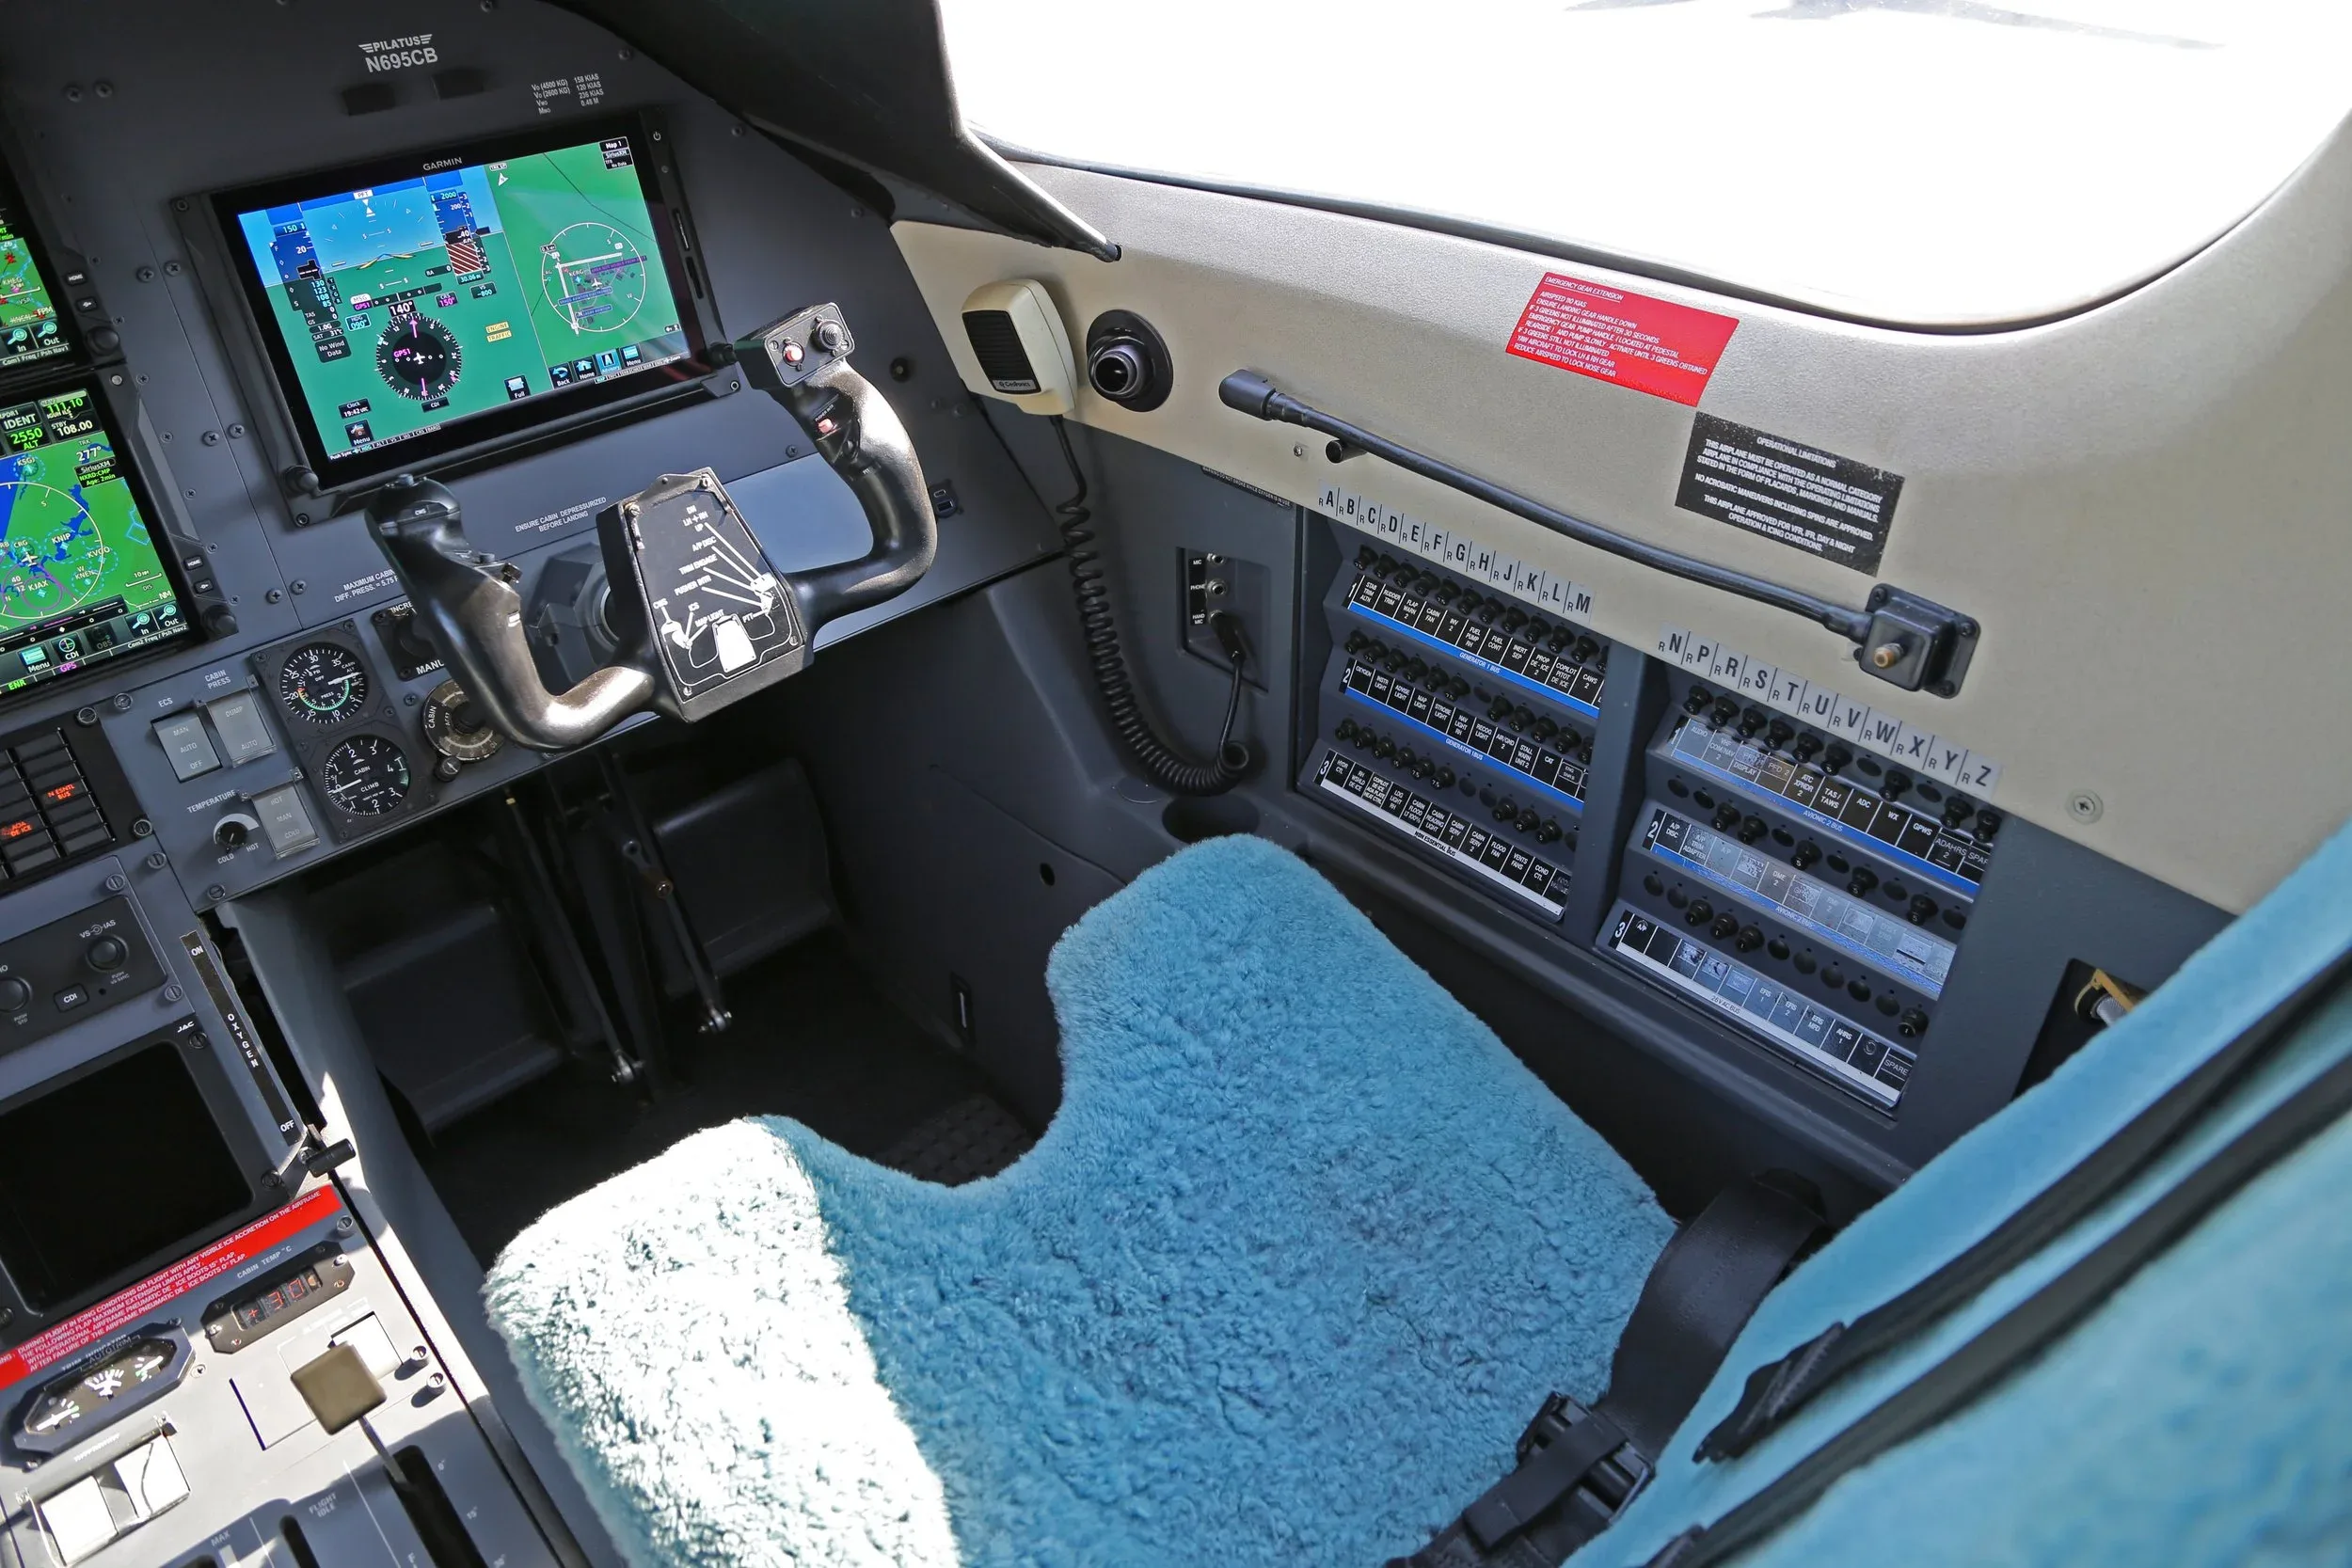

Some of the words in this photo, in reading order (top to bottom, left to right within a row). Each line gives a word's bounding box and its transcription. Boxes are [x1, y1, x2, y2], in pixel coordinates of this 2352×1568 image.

[373, 36, 421, 53] PILATUS
[365, 47, 438, 73] N695CB
[423, 157, 462, 171] GARMIN
[440, 190, 457, 199] 2000
[282, 224, 297, 234] 150
[296, 245, 307, 254] 20
[311, 279, 325, 288] 130
[1545, 276, 1578, 289] EMERGENCY
[1577, 284, 1593, 293] GEAR
[1591, 288, 1624, 300] EXTENSION
[355, 301, 371, 310] GPS1
[389, 301, 414, 314] 140°
[1535, 297, 1557, 309] ENSURE
[1556, 303, 1581, 314] LANDING
[1580, 309, 1597, 319] GEAR
[1596, 313, 1619, 325] HANDLE
[1618, 319, 1637, 329] DOWN
[350, 319, 367, 329] 090°
[486, 322, 508, 332] ENGINE
[44, 337, 60, 346] Out
[487, 331, 512, 341] TRAFFIC
[328, 340, 345, 350] Wind
[326, 348, 342, 357] Data
[557, 378, 570, 387] Back
[47, 398, 83, 414] 111.10
[6, 413, 36, 430] IDENT
[56, 420, 93, 436] 108.00
[10, 428, 43, 443] 2550
[353, 436, 371, 446] Menu
[23, 439, 39, 450] ALT
[76, 446, 102, 461] 277°
[1756, 436, 1799, 456] OPERATIONAL
[1798, 450, 1836, 468] LIMITATIONS
[1705, 438, 1719, 451] THIS
[1718, 443, 1748, 460] AIRPLANE
[1747, 452, 1765, 466] MUST
[1764, 458, 1774, 468] BE
[1773, 461, 1806, 479] OPERATED
[1805, 471, 1816, 482] AS
[1814, 474, 1820, 483] A
[1820, 476, 1848, 493] NORMAL
[1847, 484, 1883, 504] CATEGORY
[516, 519, 540, 532] ENSURE
[539, 511, 558, 526] CABIN
[559, 497, 607, 519] DEPRESSURIZED
[538, 519, 562, 532] BEFORE
[563, 511, 589, 526] LANDING
[52, 532, 71, 545] KNIP
[1326, 490, 1334, 507] A
[1346, 499, 1354, 515] B
[1368, 507, 1375, 524] C
[1389, 515, 1398, 532] D
[1411, 525, 1420, 543] E
[1433, 533, 1442, 551] F
[1455, 544, 1465, 562] G
[1479, 552, 1489, 571] H
[1503, 564, 1513, 581] J
[1526, 572, 1538, 592] K
[1552, 583, 1561, 603] L
[1575, 593, 1591, 613] M
[28, 580, 49, 592] KJAX
[343, 576, 374, 592] MAXIMUM
[165, 616, 179, 626] Out
[140, 626, 150, 635] In
[1470, 626, 1480, 636] FUEL
[1465, 632, 1478, 642] PUMP
[1491, 635, 1503, 645] FUEL
[1487, 641, 1501, 652] CONT
[1513, 643, 1526, 655] INERT
[65, 651, 79, 660] CDI
[1512, 651, 1521, 660] SEP
[1535, 654, 1549, 664] PROP
[28, 662, 50, 673] Menu
[331, 658, 342, 668] 35
[1556, 661, 1575, 675] COPILOT
[205, 670, 227, 683] CABIN
[1555, 670, 1570, 681] PITOT
[1583, 673, 1597, 685] CAWS
[8, 679, 26, 690] ENR
[207, 676, 230, 690] PRESS
[158, 697, 173, 708] ECS
[332, 709, 340, 718] 10
[1669, 633, 1682, 653] N
[1696, 645, 1709, 662] P
[1725, 657, 1739, 677] R
[1756, 670, 1768, 689] S
[1787, 682, 1799, 703] T
[1815, 695, 1830, 715] U
[1847, 708, 1861, 729] V
[1876, 721, 1896, 744] W
[1908, 736, 1925, 758] X
[1945, 750, 1959, 771] Y
[1975, 765, 1992, 786] Z
[180, 741, 197, 753] AUTO
[240, 739, 258, 751] AUTO
[190, 760, 203, 770] OFF
[1544, 754, 1553, 765] CAT
[1733, 760, 1756, 776] DISPLAY
[360, 782, 379, 793] CLIMB
[187, 789, 236, 814] TEMPERATURE
[1820, 795, 1839, 810] TAWS
[1856, 796, 1871, 809] ADC
[1803, 808, 1824, 824] AVIONIC
[1823, 817, 1830, 826] 2
[1829, 820, 1843, 832] BUS
[1887, 810, 1899, 821] WX
[1669, 821, 1679, 832] A/P
[1912, 820, 1932, 837] GPWS
[1665, 828, 1678, 839] DISC
[246, 843, 260, 852] HOT
[1935, 836, 1966, 857] ADAHRS
[217, 853, 234, 864] COLD
[1513, 852, 1528, 864] VENTS
[1509, 858, 1523, 871] FANS
[1534, 863, 1549, 876] COND
[1533, 871, 1543, 881] CTL
[79, 929, 91, 938] VS
[103, 919, 116, 928] IAS
[191, 945, 203, 956] ON
[63, 992, 77, 1003] CDI
[1835, 1026, 1852, 1040] AHRS
[227, 1014, 259, 1068] OXYGEN
[1883, 1057, 1910, 1077] SPARE
[280, 1119, 294, 1132] OFF
[237, 1262, 259, 1278] CABIN
[262, 1253, 280, 1267] TEMP
[17, 1336, 44, 1354] DURING
[44, 1323, 69, 1339] FLIGHT
[68, 1319, 76, 1327] IN
[76, 1308, 95, 1323] ICING
[95, 1288, 136, 1313] CONDITIONS
[135, 1282, 147, 1291] OR
[147, 1271, 168, 1286] FLIGHT
[169, 1261, 186, 1274] WITH
[185, 1255, 199, 1265] ANY
[200, 1243, 223, 1258] VISIBLE
[223, 1236, 234, 1246] ICE
[233, 1217, 270, 1240] ACCRETION
[269, 1212, 279, 1222] ON
[278, 1206, 292, 1217] THE
[292, 1190, 322, 1211] AIRFRAME
